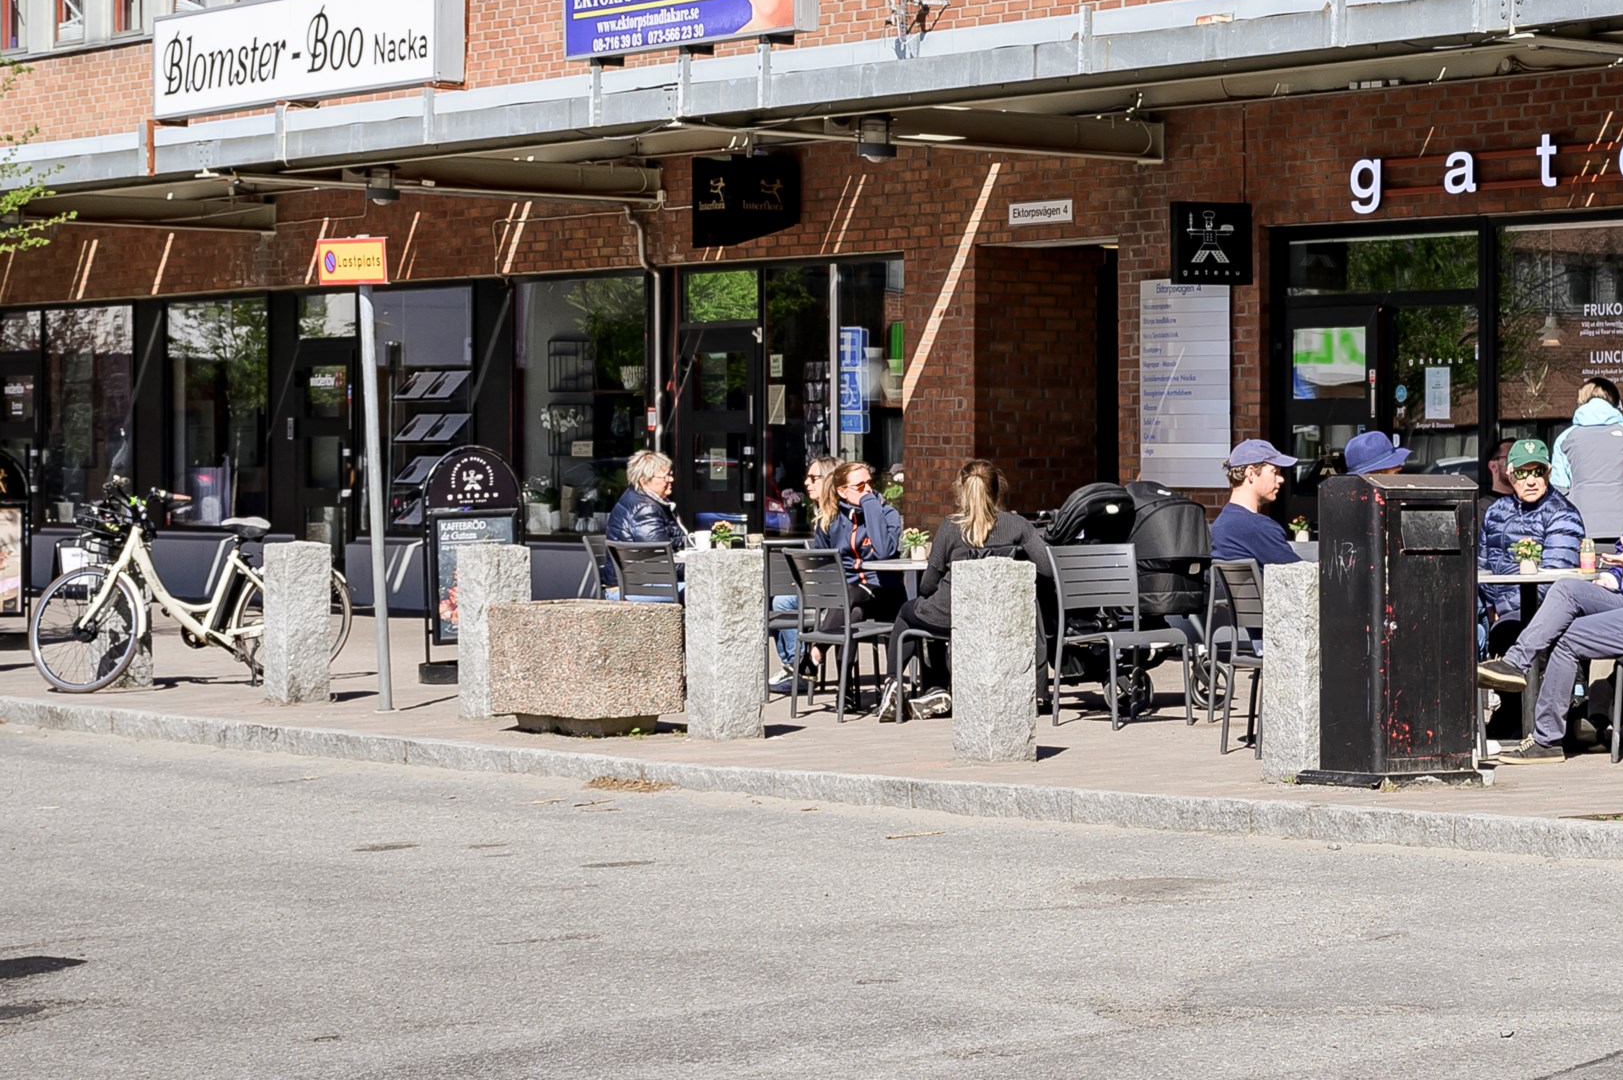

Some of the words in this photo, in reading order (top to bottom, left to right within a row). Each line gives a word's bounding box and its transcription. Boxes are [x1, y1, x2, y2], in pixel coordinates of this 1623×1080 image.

[596, 6, 700, 33] www.ektorpstandlakare.se
[593, 36, 620, 52] 08-716
[620, 35, 631, 49] 39
[631, 32, 643, 47] 03
[647, 27, 681, 44] 073-566
[681, 25, 693, 40] 23
[693, 23, 704, 38] 30
[373, 28, 428, 65] Nacka
[698, 200, 726, 211] Interflora
[743, 200, 784, 211] Interflora
[1012, 206, 1061, 219] Ektorpsvägen
[1062, 204, 1068, 215] 4
[337, 255, 381, 270] Lastplats
[1182, 269, 1240, 277] gateau
[1196, 284, 1202, 292] 4
[1408, 357, 1463, 366] gateau
[446, 492, 499, 501] gateau
[440, 520, 487, 532] KAFFEBRÖD
